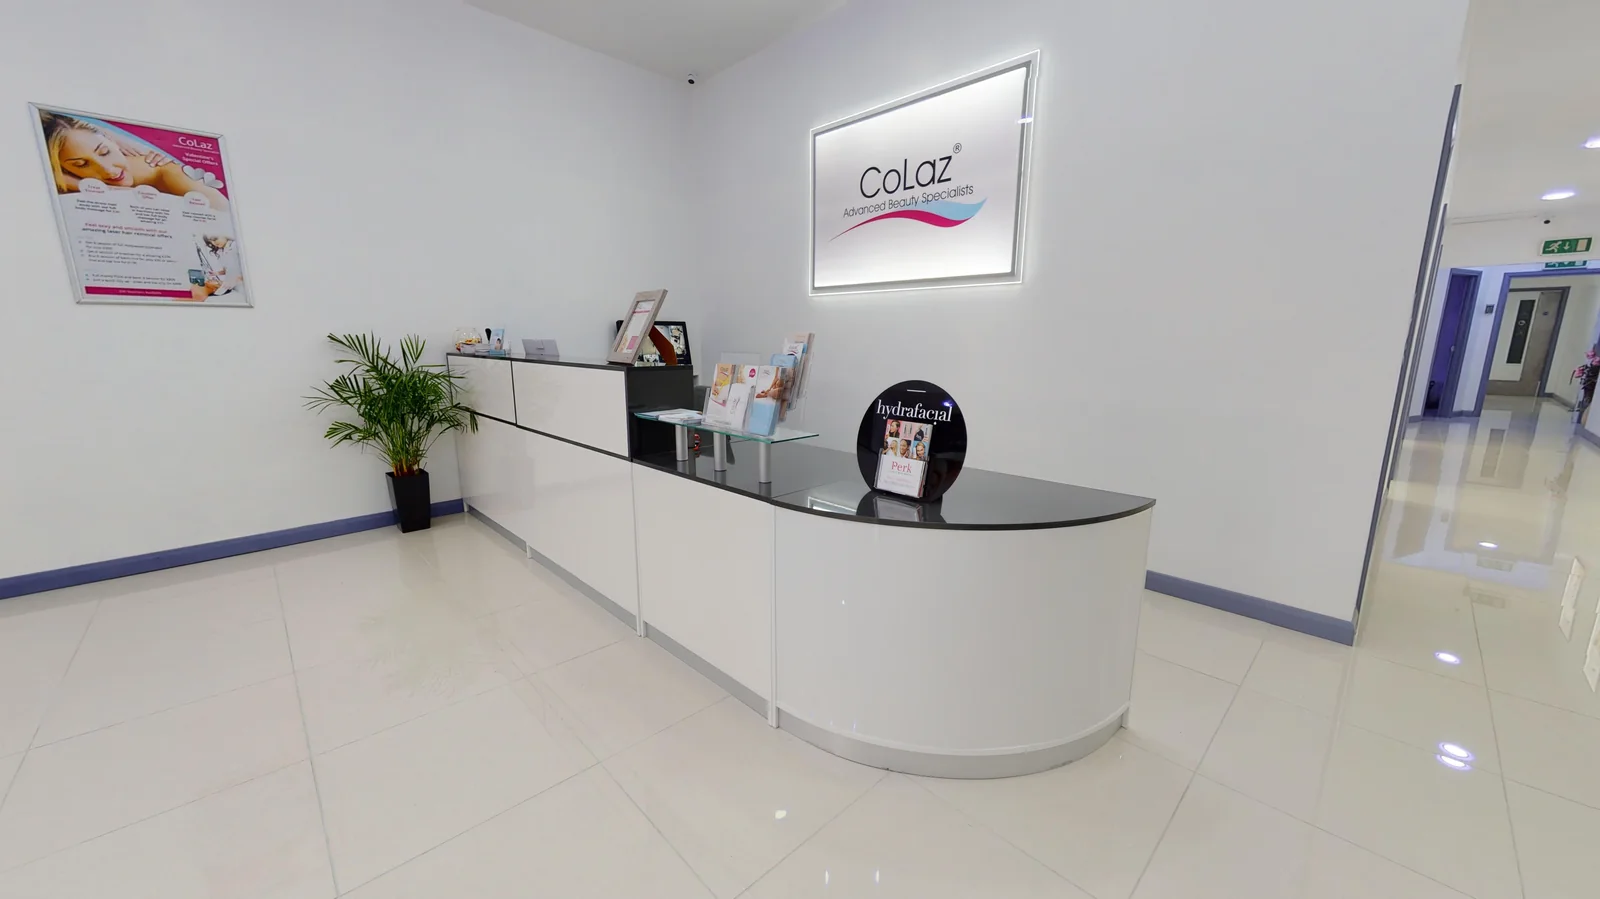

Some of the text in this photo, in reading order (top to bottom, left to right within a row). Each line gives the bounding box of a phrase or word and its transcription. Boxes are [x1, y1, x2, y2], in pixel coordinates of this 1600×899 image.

[178, 136, 213, 150] CoLaz
[181, 155, 202, 164] Special
[860, 155, 953, 199] CoLaz
[843, 184, 974, 218] Advanced Beauty Specialists
[876, 399, 953, 424] hydrafacial
[891, 460, 912, 474] Perk
